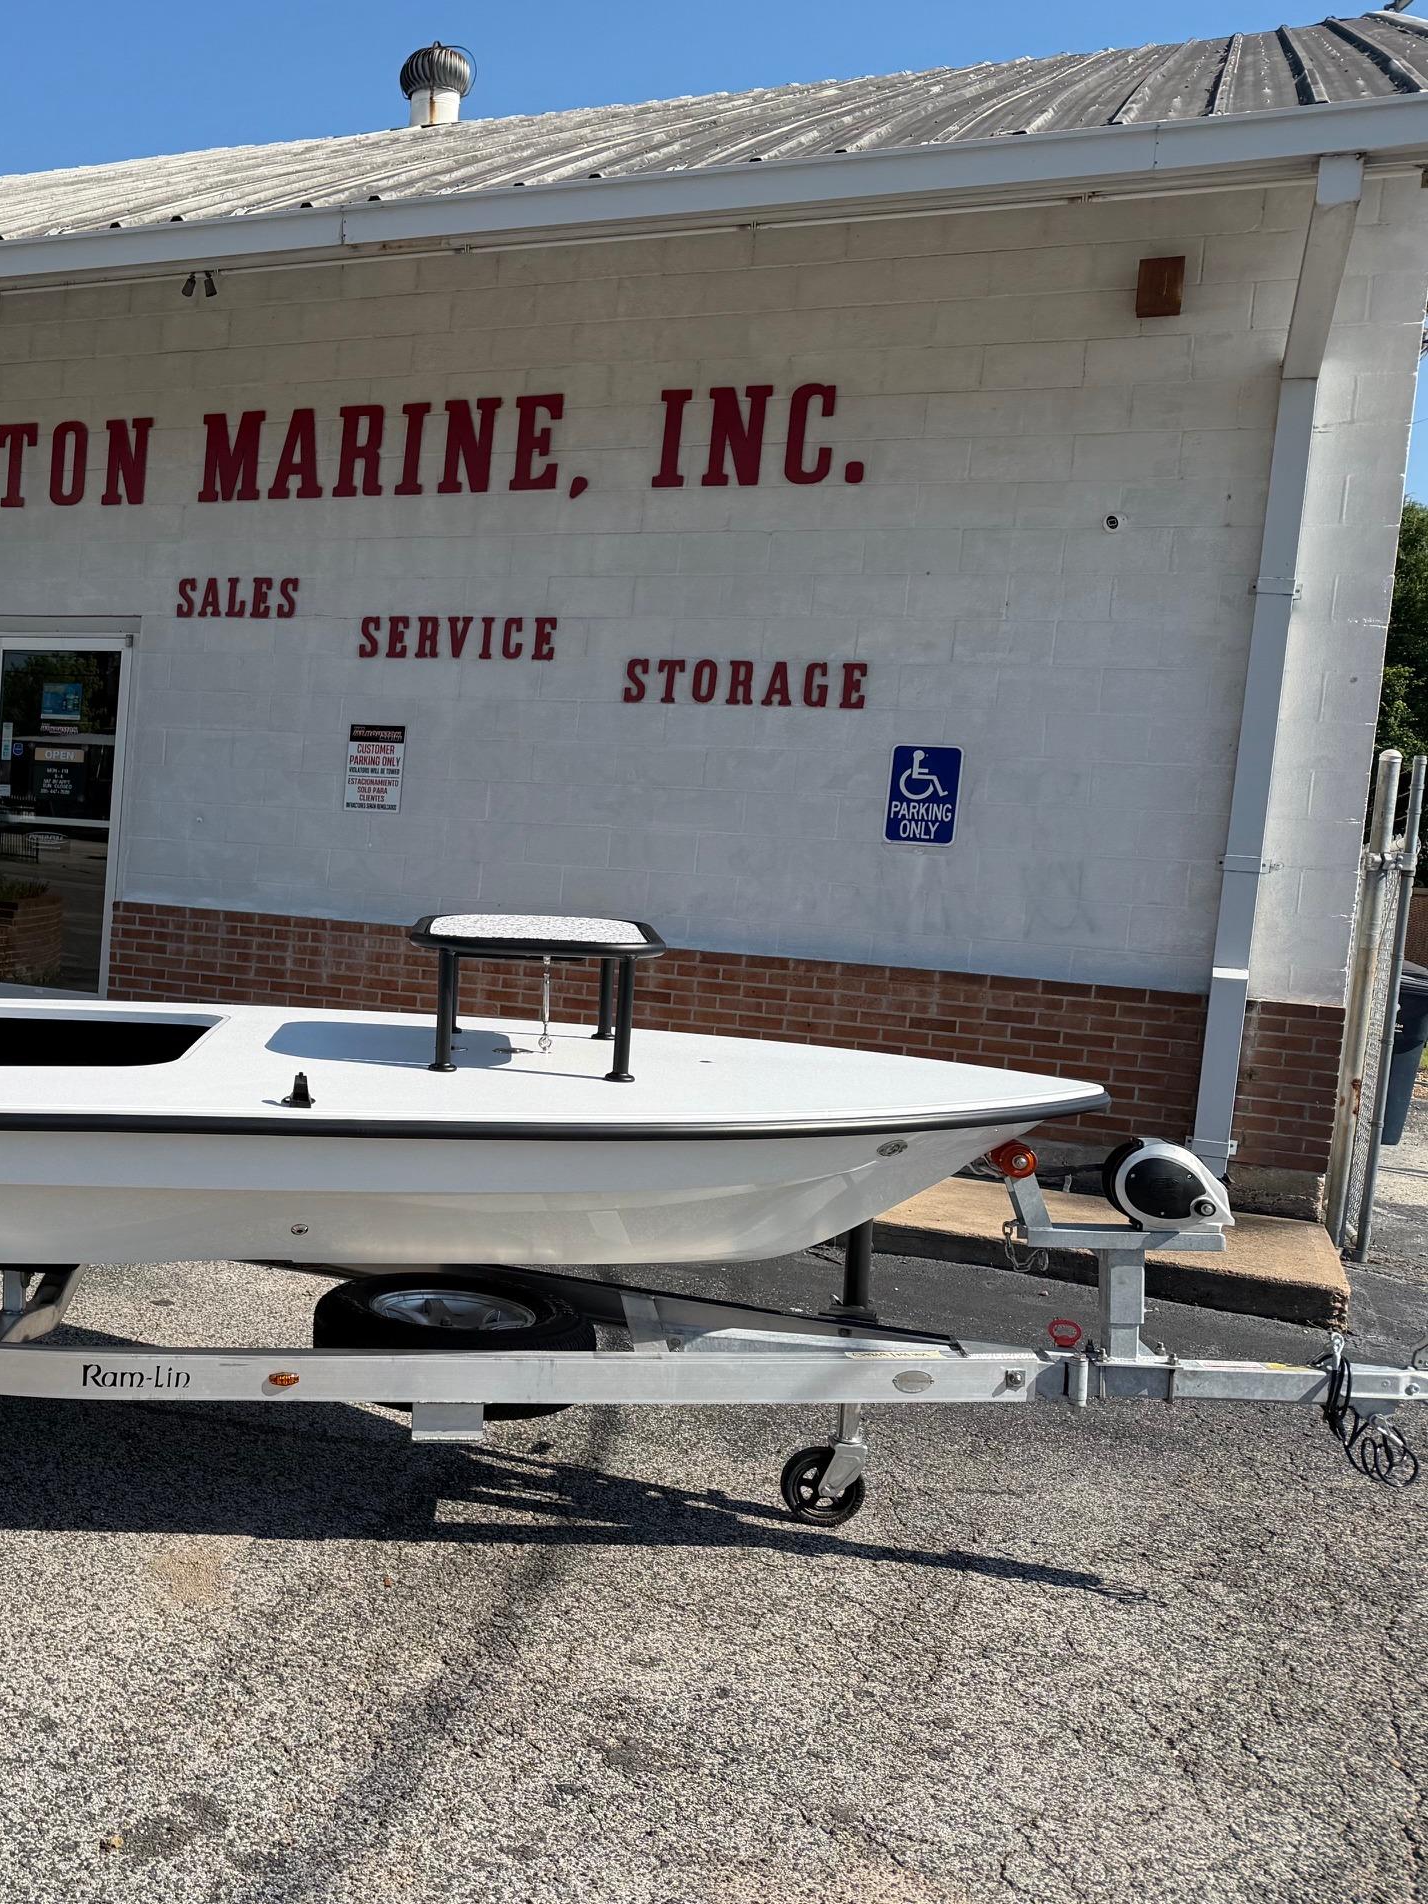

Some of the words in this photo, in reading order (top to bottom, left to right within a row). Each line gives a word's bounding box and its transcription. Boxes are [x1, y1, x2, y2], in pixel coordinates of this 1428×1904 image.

[197, 392, 589, 503] MARINE,
[651, 382, 865, 488] INC.
[176, 576, 301, 619] SALES
[358, 615, 559, 661] SERVICE
[623, 658, 869, 710] STORAGE
[44, 749, 75, 760] OPEN
[357, 743, 395, 754] CUSTOMER
[349, 755, 380, 766] PARKING
[381, 756, 401, 767] ONLY
[347, 777, 399, 787] ESTACIONAMIENTO
[357, 786, 371, 794] SOLO
[372, 787, 388, 795] PARA
[359, 794, 385, 802] CLIENTES
[890, 801, 952, 821] PARKING
[899, 820, 939, 839] ONLY
[82, 1363, 191, 1388] Ram-Lin
